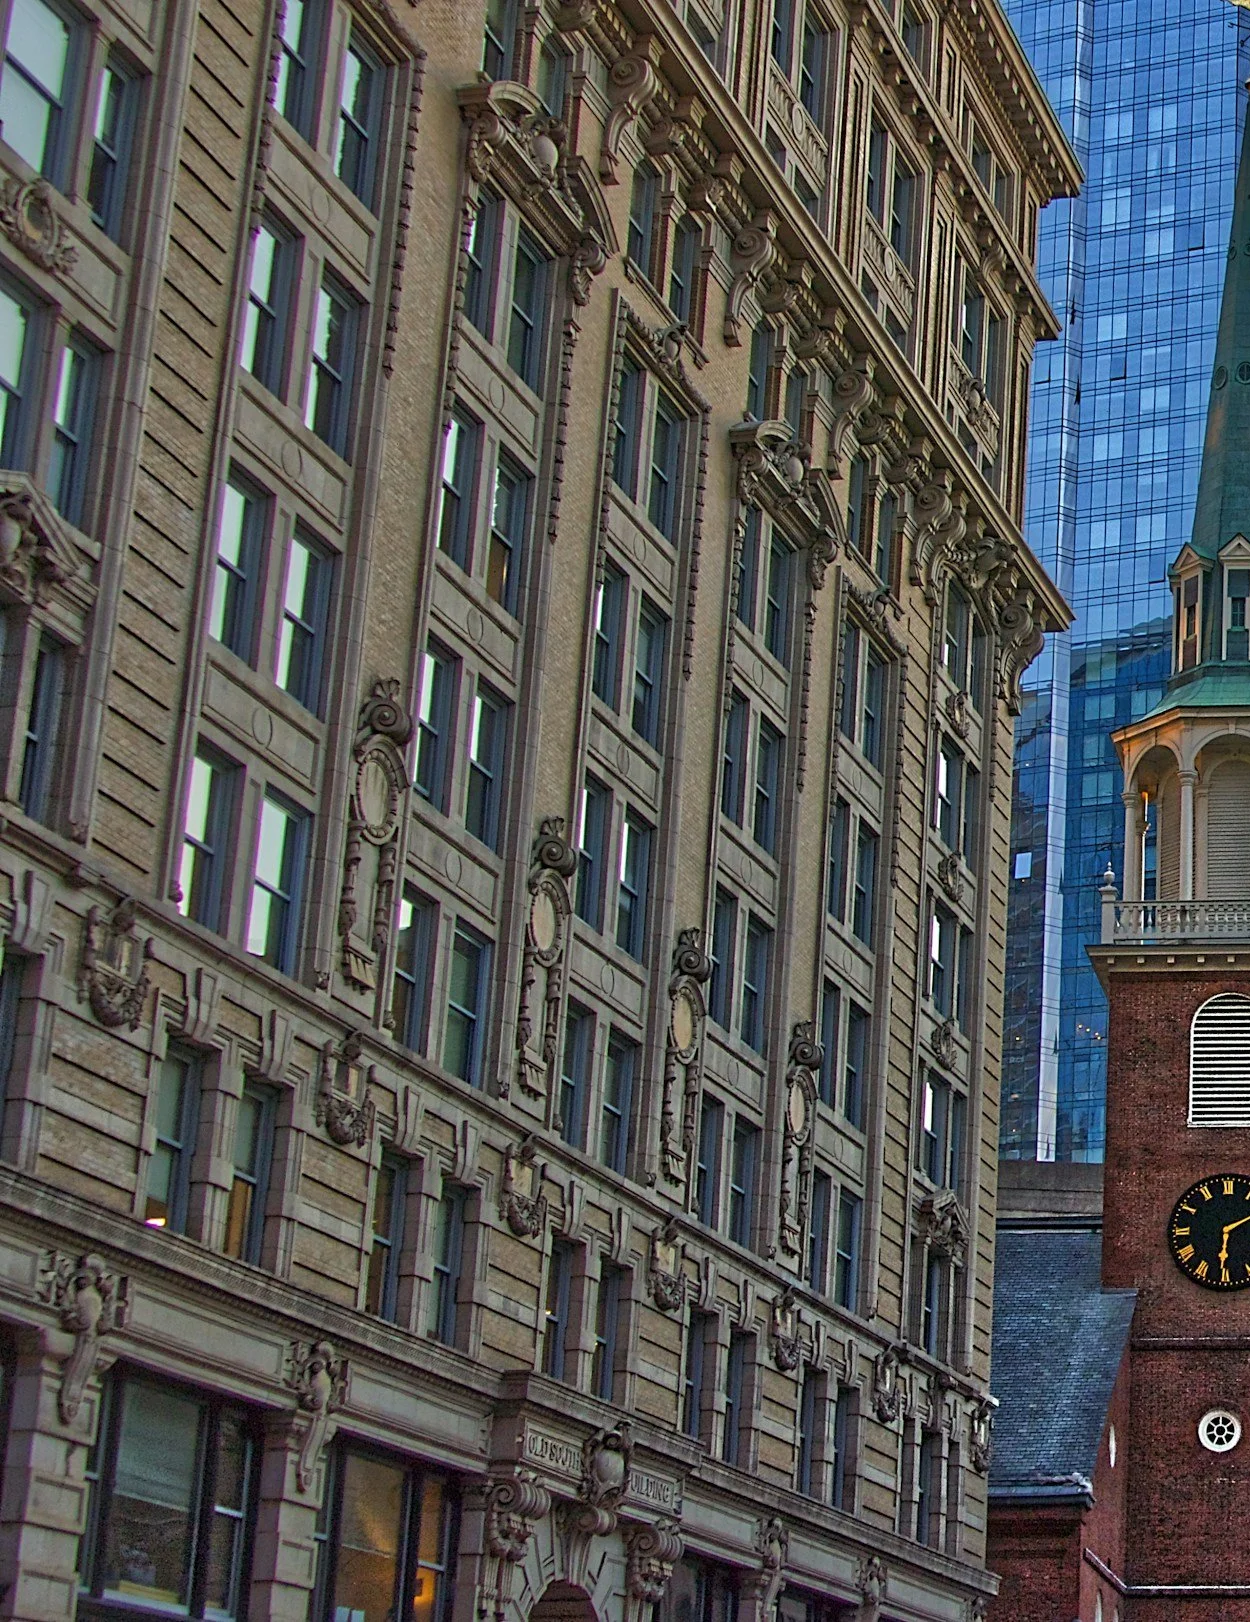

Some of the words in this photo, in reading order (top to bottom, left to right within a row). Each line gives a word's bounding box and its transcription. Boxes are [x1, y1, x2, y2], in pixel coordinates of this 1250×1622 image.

[528, 1434, 548, 1458] OLD
[549, 1442, 581, 1471] SOUTH
[630, 1472, 669, 1503] UILDING
